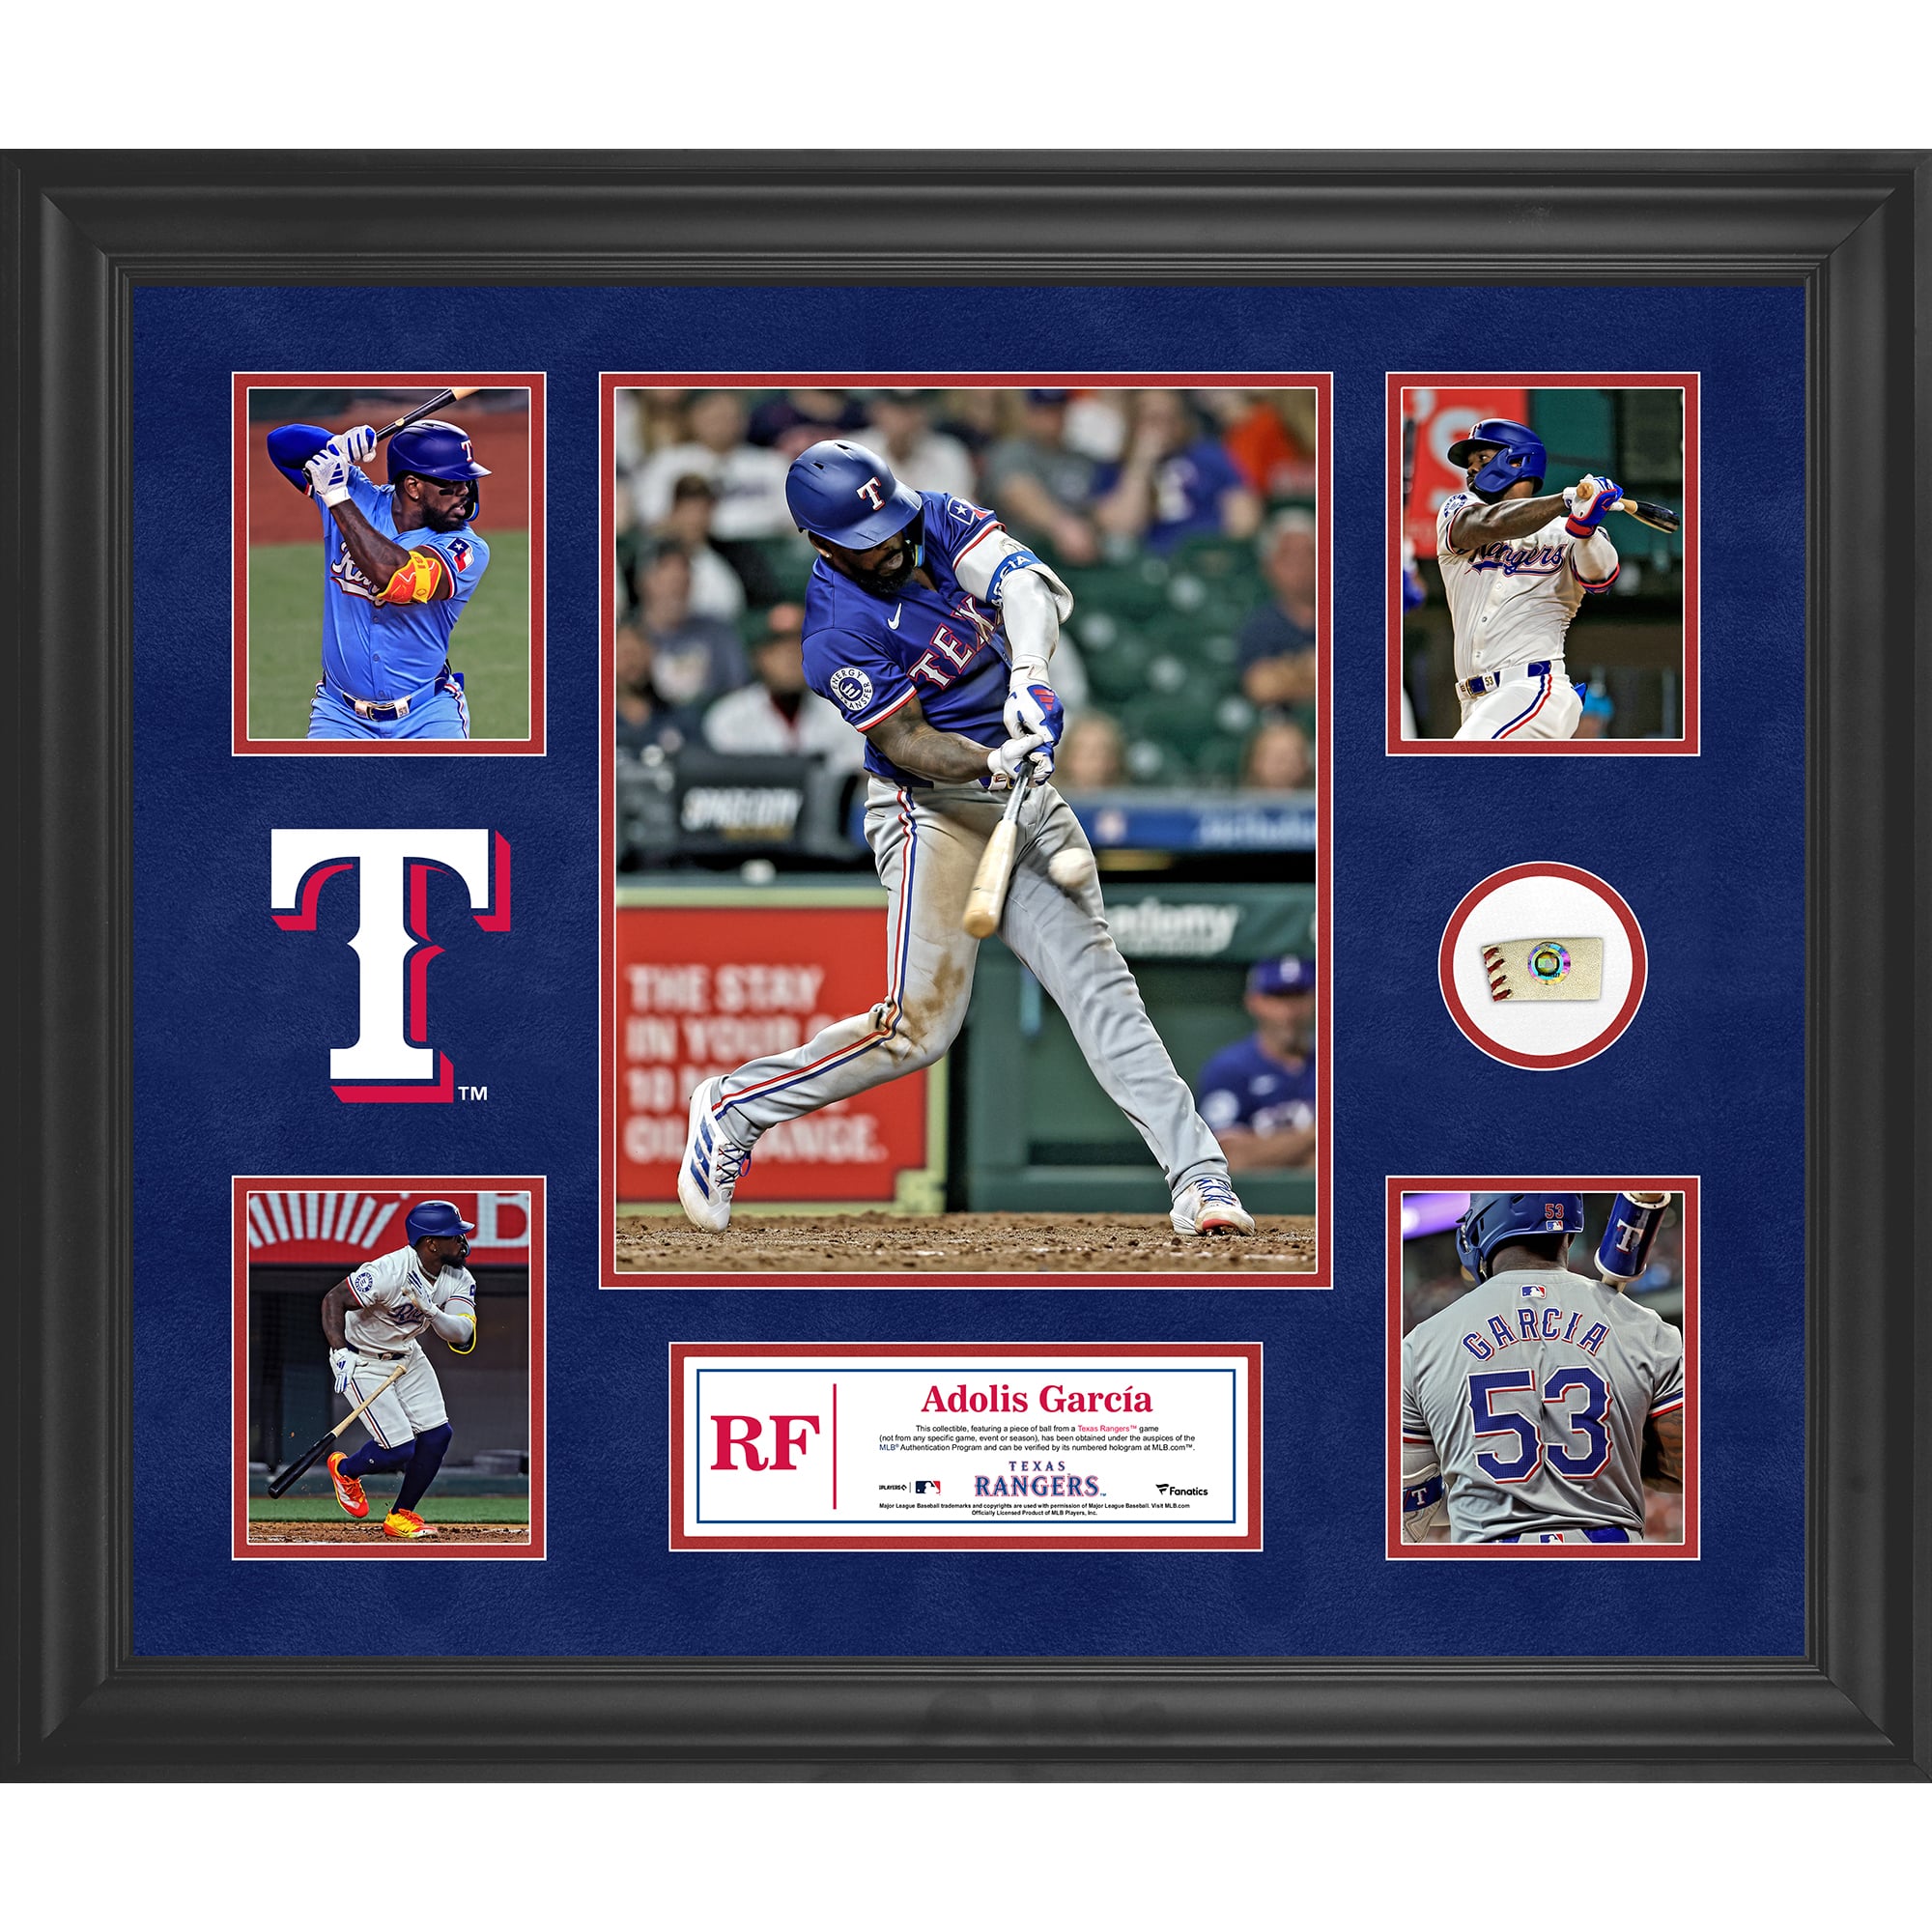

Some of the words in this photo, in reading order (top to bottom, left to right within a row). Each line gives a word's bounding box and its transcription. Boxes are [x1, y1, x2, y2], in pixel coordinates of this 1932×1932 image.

[856, 476, 885, 510] T
[1466, 541, 1569, 578] angers
[906, 593, 1003, 691] TEX
[832, 668, 863, 690] ENERGY
[270, 828, 511, 1103] T
[458, 1086, 488, 1101] TM
[626, 963, 711, 1013] THE
[715, 963, 824, 1013] STAY
[625, 1016, 678, 1062] IN
[1545, 1203, 1565, 1219] 53
[1615, 1218, 1645, 1254] T
[1461, 1307, 1610, 1362] GARCIA
[921, 1384, 1029, 1413] Adolis
[1038, 1384, 1154, 1413] García
[971, 1425, 1002, 1434] featuring
[1100, 1425, 1138, 1434] Rangers™
[1466, 1365, 1614, 1485] 53
[710, 1414, 820, 1472] RF
[1009, 1461, 1065, 1472] TEXAS
[974, 1474, 1099, 1498] RANGERS
[1169, 1485, 1209, 1496] Fanatics
[1411, 1488, 1428, 1505] T
